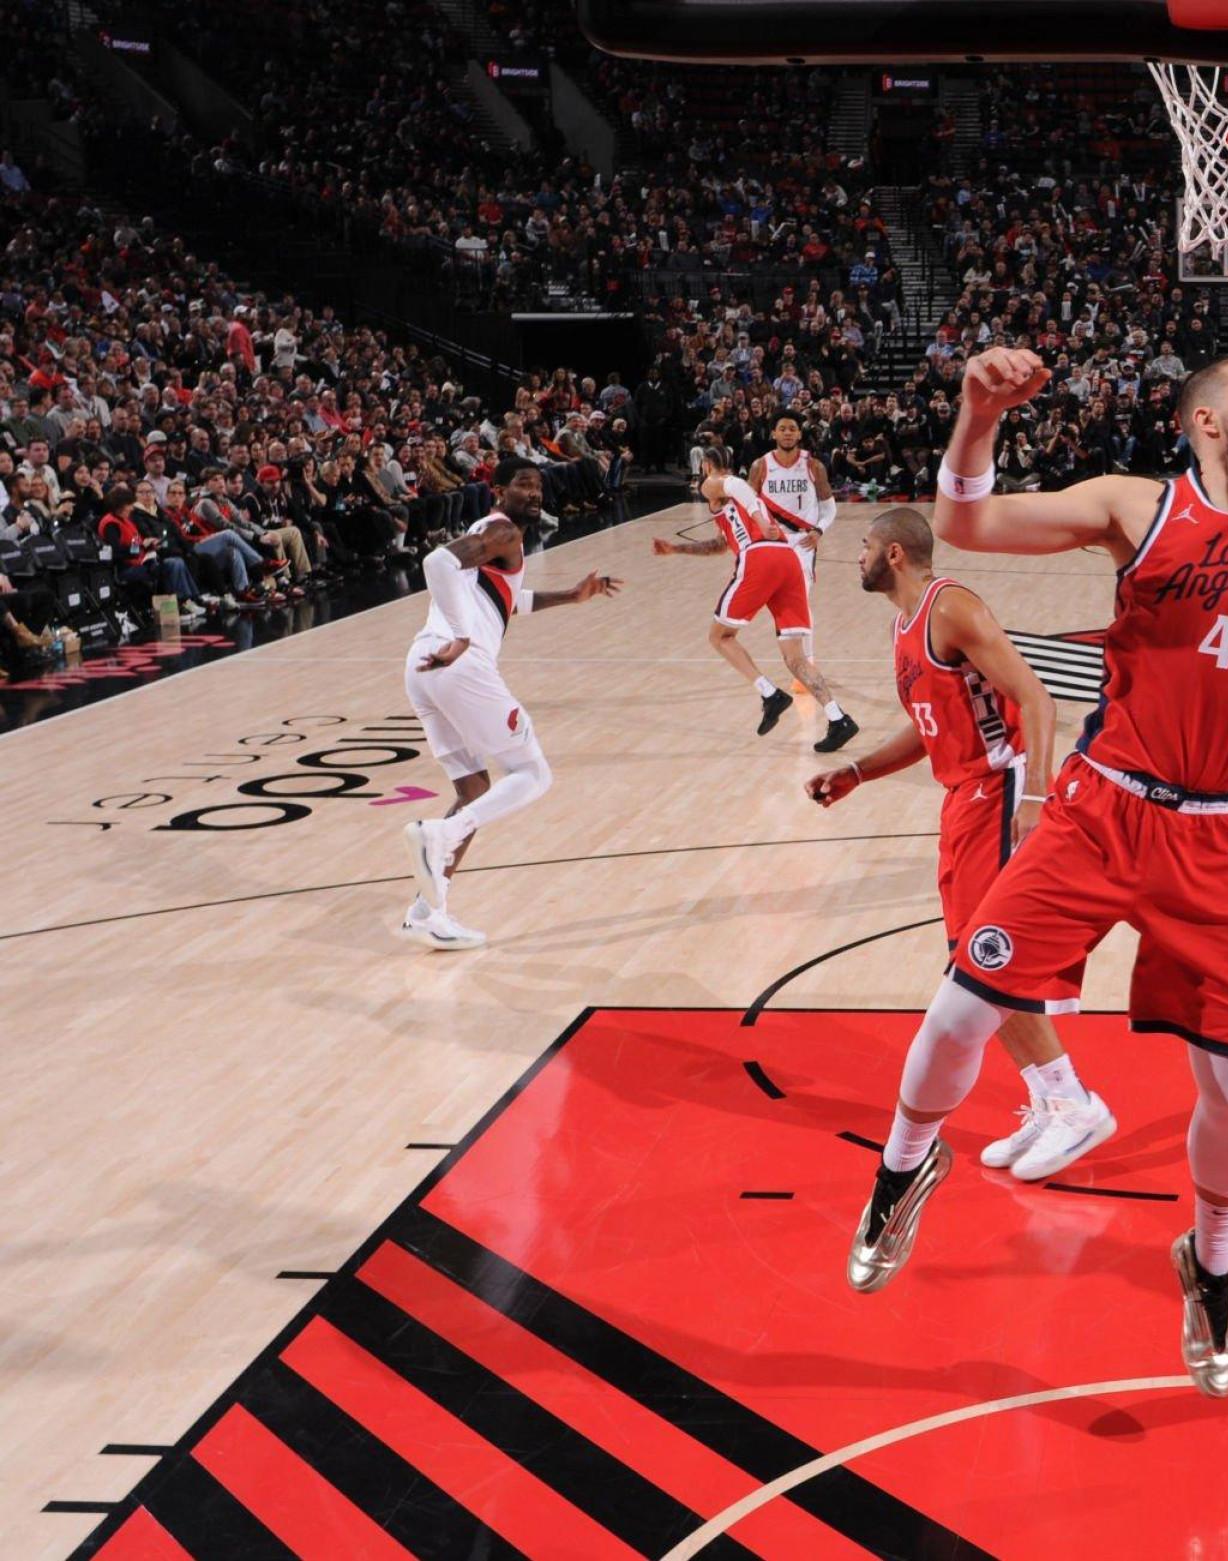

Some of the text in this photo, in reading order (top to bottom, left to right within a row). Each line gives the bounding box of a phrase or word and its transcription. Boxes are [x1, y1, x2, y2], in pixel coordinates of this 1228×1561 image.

[768, 480, 808, 494] BLAZERS
[796, 495, 802, 511] 1
[46, 714, 348, 831] center
[1150, 786, 1179, 801] Clips
